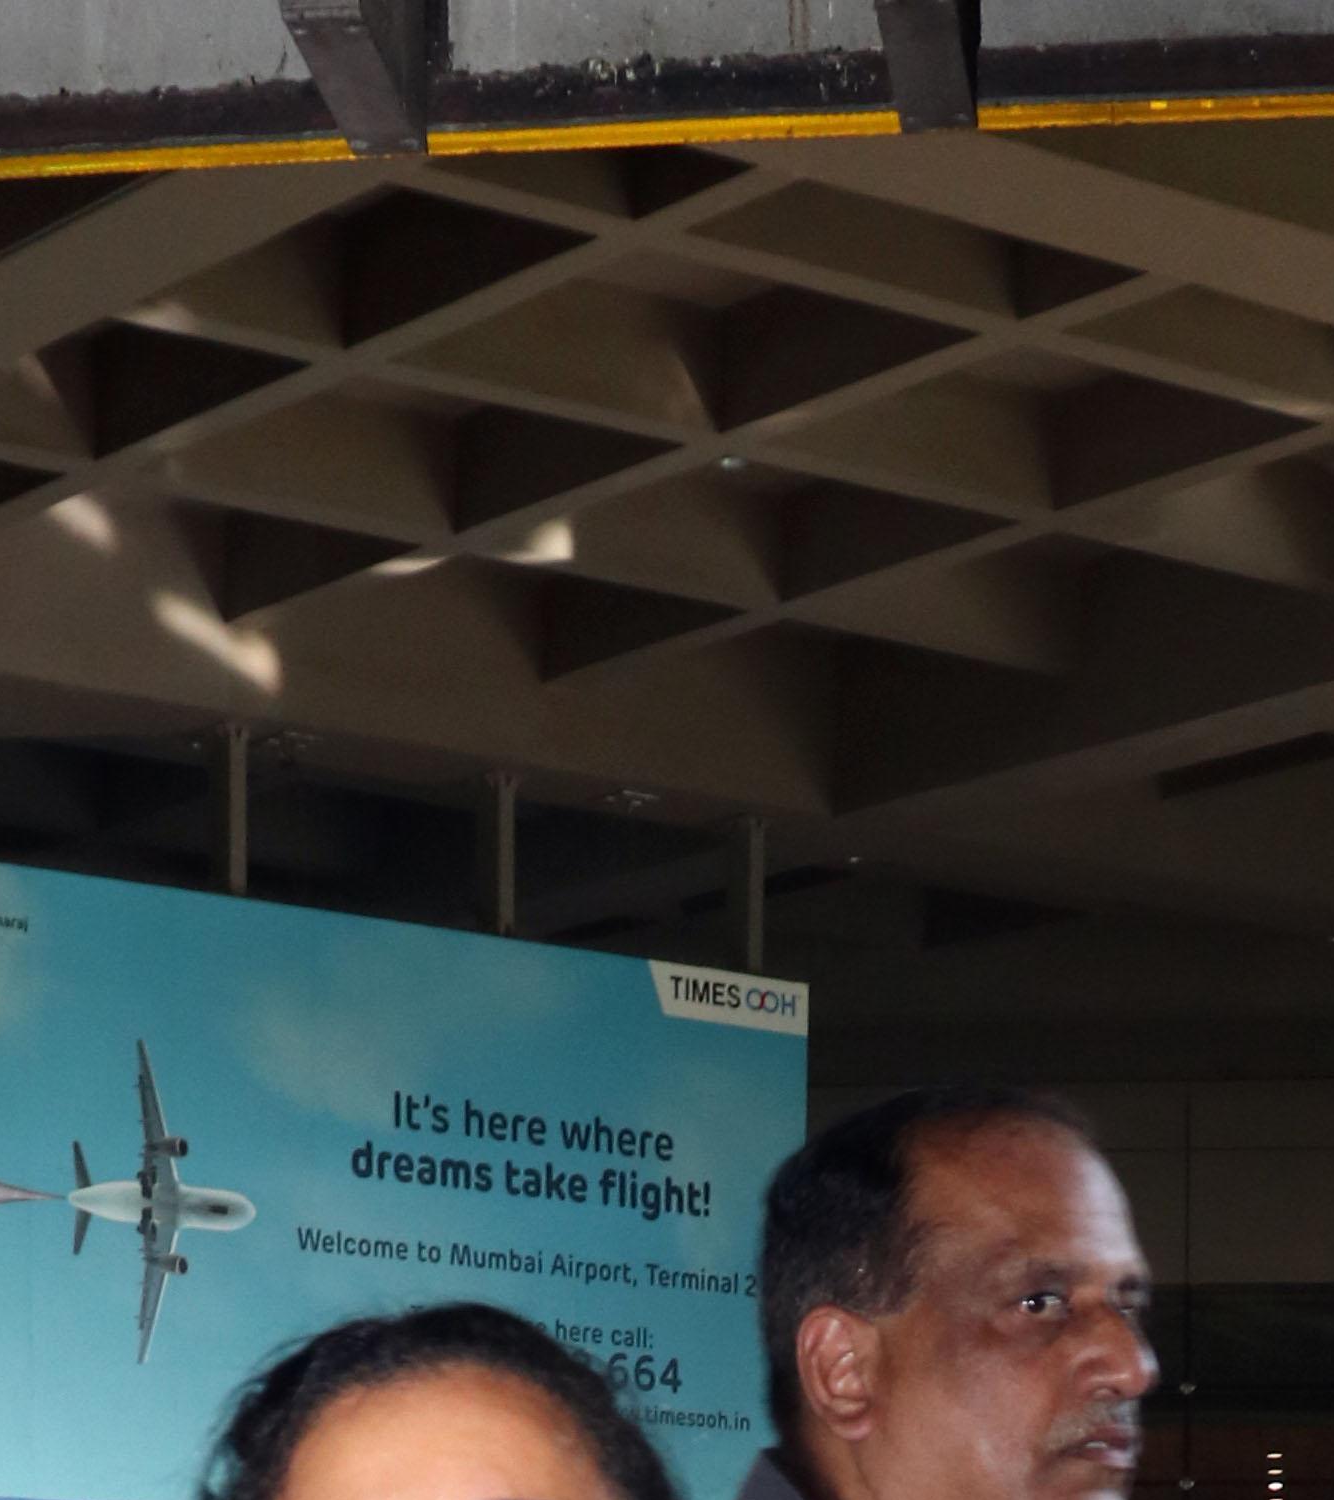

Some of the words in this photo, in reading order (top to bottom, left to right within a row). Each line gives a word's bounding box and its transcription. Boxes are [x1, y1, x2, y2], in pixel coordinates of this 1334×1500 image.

[670, 976, 741, 1008] TIMES
[746, 988, 796, 1016] OOH
[394, 1091, 450, 1134] It's
[464, 1099, 547, 1146] here
[561, 1116, 674, 1161] where
[352, 1141, 492, 1193] dreams
[505, 1160, 588, 1202] take
[599, 1169, 711, 1221] flight!
[297, 1226, 409, 1262] Welcome
[417, 1240, 441, 1264] to
[450, 1244, 543, 1275] Mumbai
[551, 1253, 637, 1289] Airport,
[646, 1263, 739, 1295] Terminal
[745, 1275, 757, 1297] 2
[555, 1318, 603, 1344] here
[611, 1326, 654, 1349] call:
